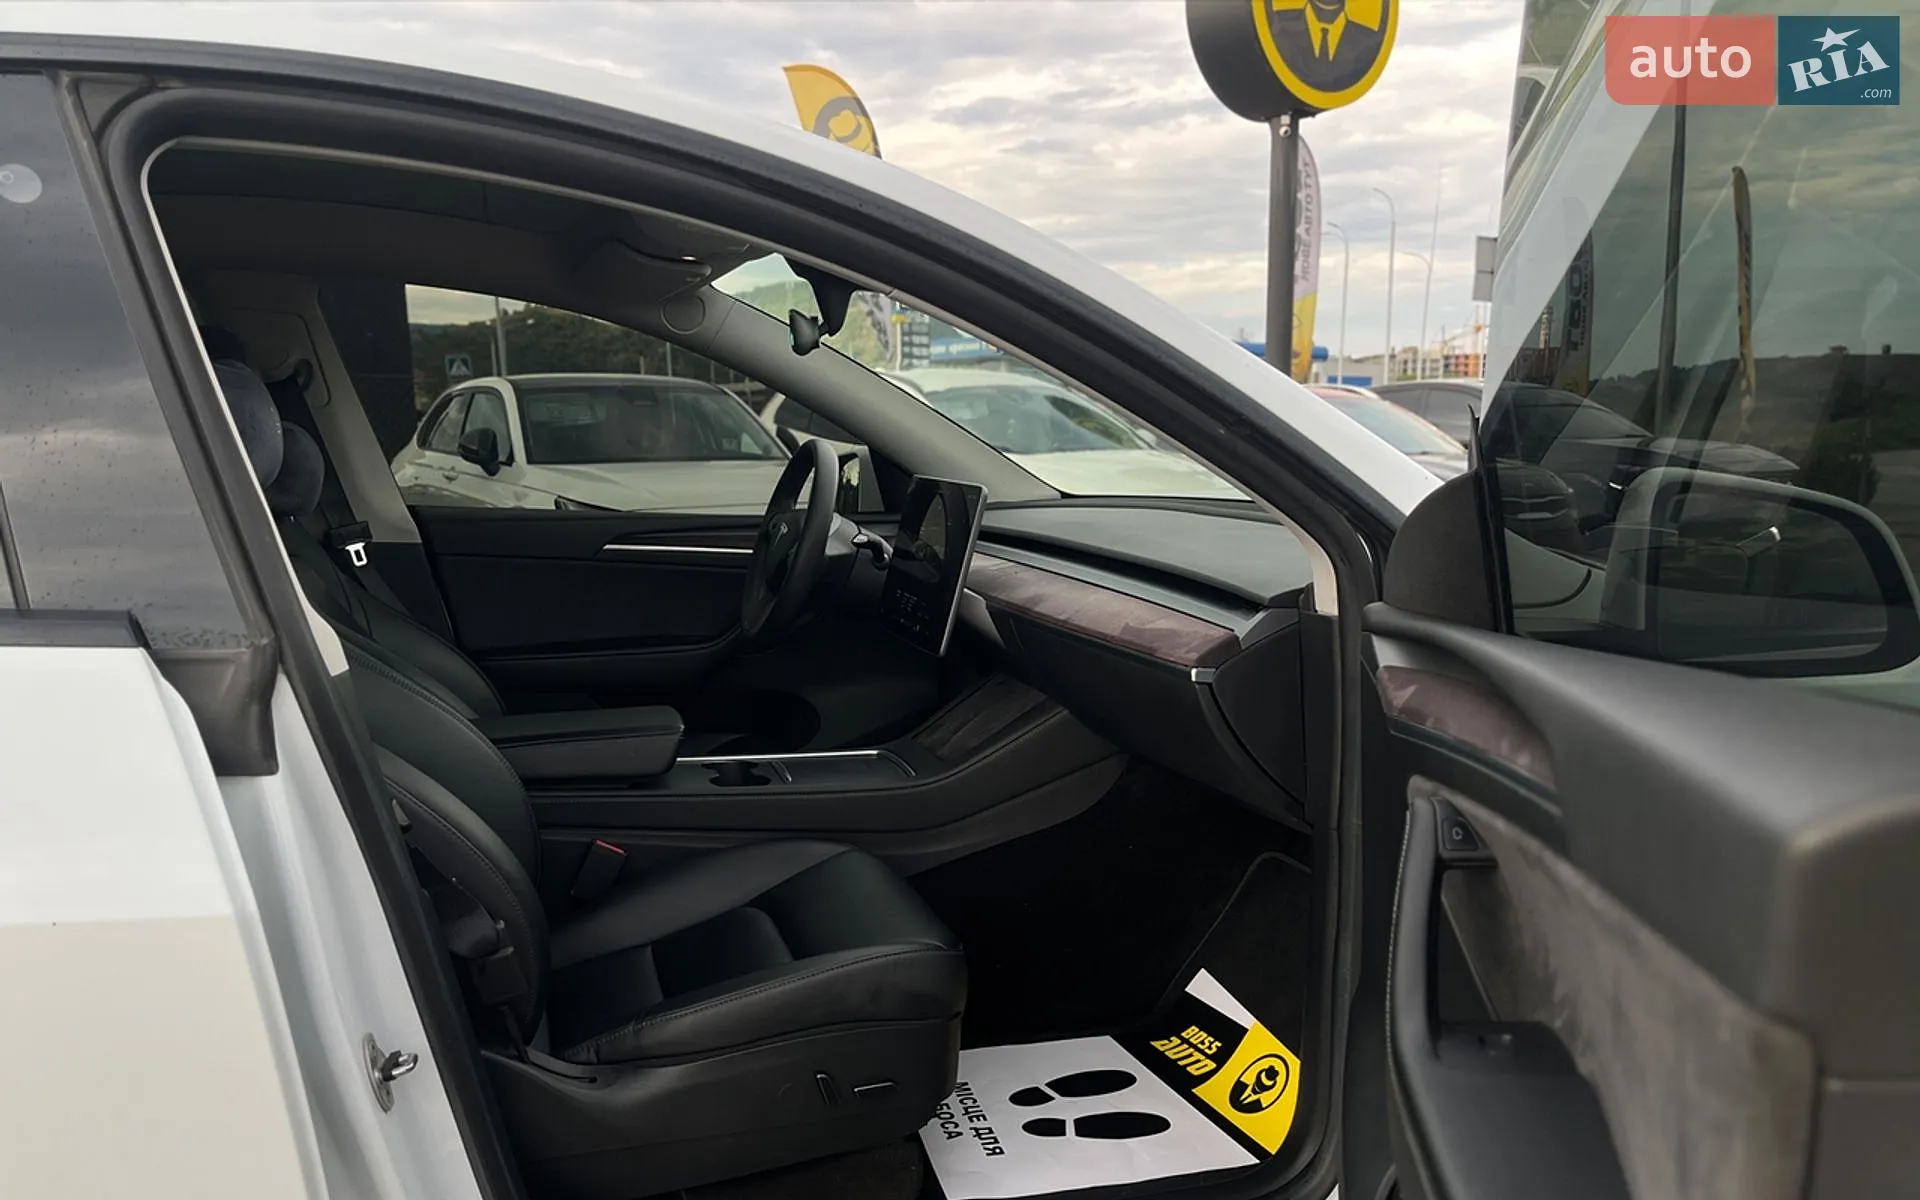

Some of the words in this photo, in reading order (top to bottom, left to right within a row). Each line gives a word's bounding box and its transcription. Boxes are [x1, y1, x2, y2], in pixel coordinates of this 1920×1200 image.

[1149, 1036, 1217, 1076] AUTO
[1180, 1025, 1222, 1055] BOSS
[955, 1081, 988, 1123] МІСЦЕ
[969, 1126, 1005, 1156] ДЛЯ
